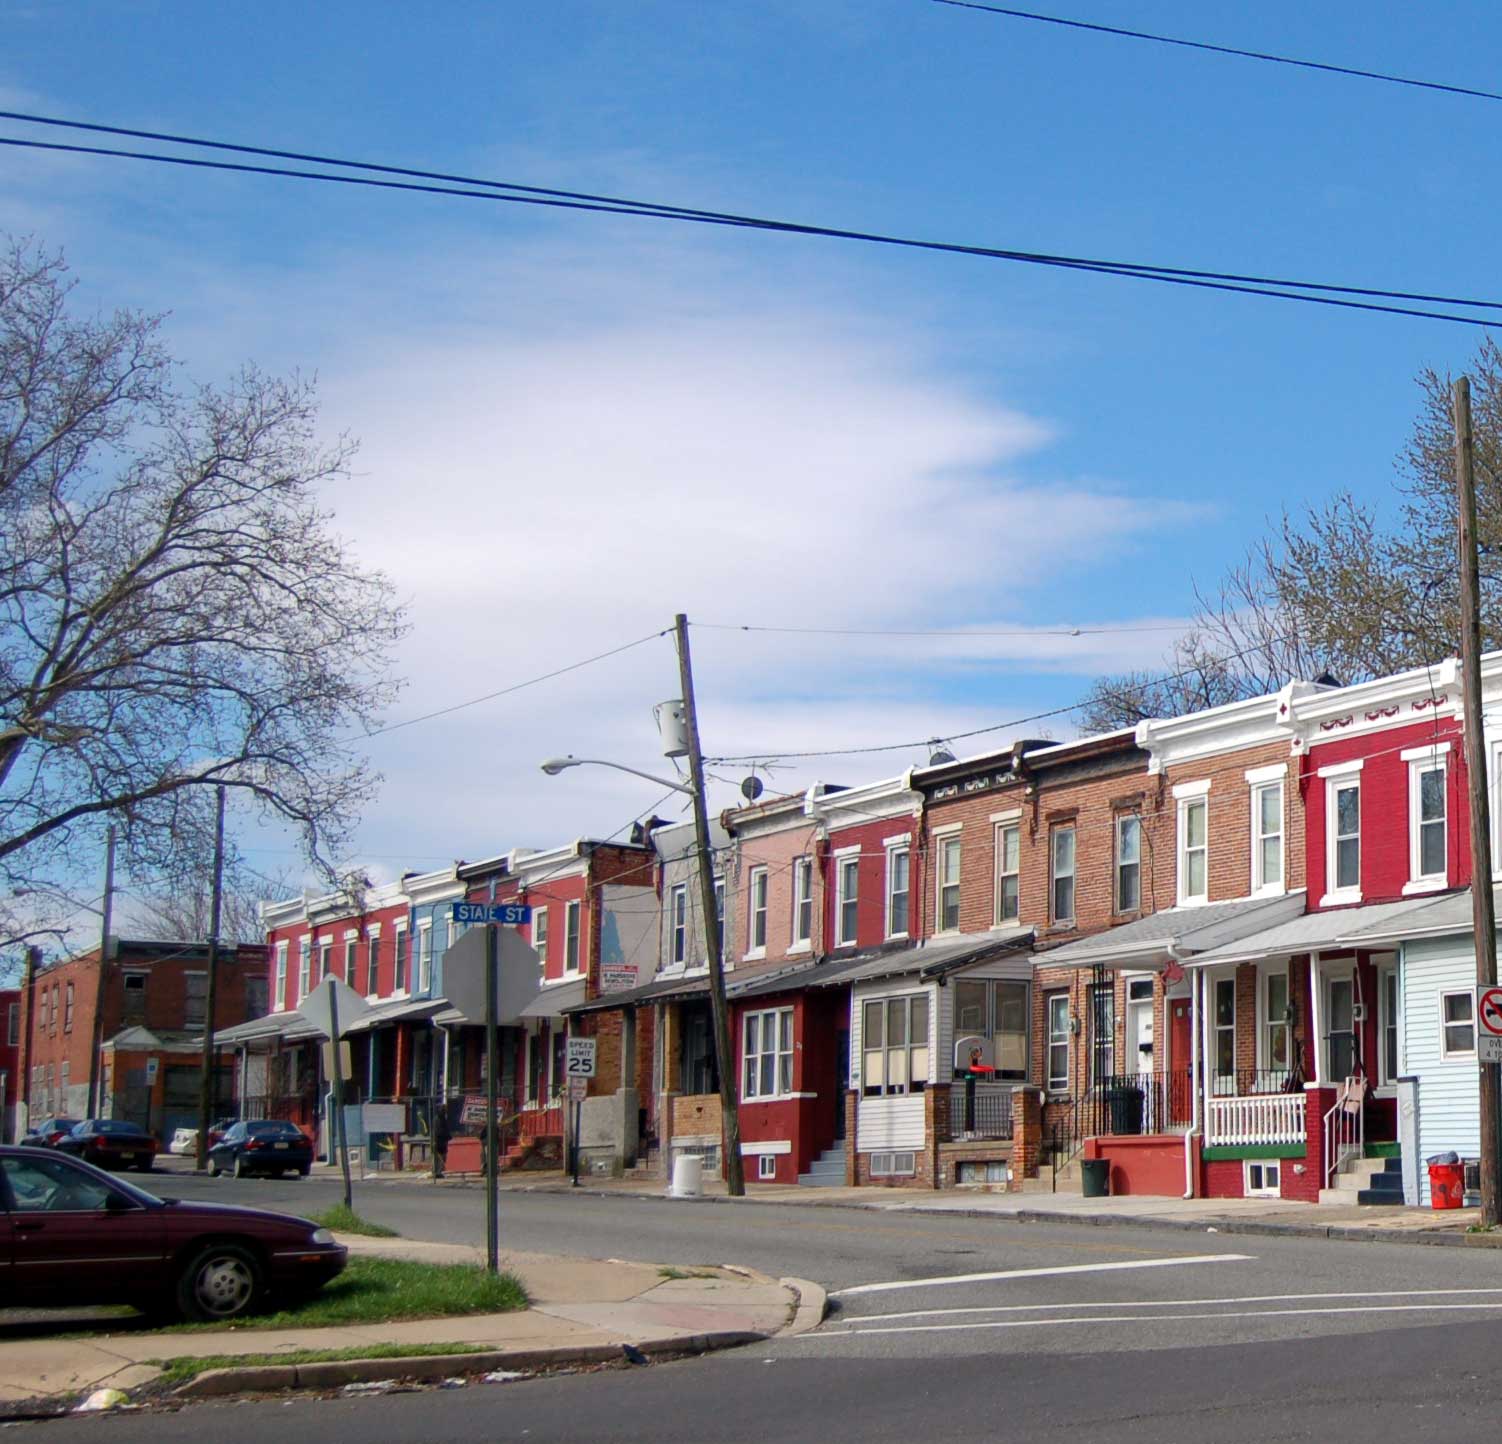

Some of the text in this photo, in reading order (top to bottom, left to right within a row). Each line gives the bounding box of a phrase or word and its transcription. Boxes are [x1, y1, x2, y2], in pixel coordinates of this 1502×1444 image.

[458, 905, 525, 921] STATE ST
[569, 1041, 594, 1049] SPEED
[569, 1058, 592, 1072] 25
